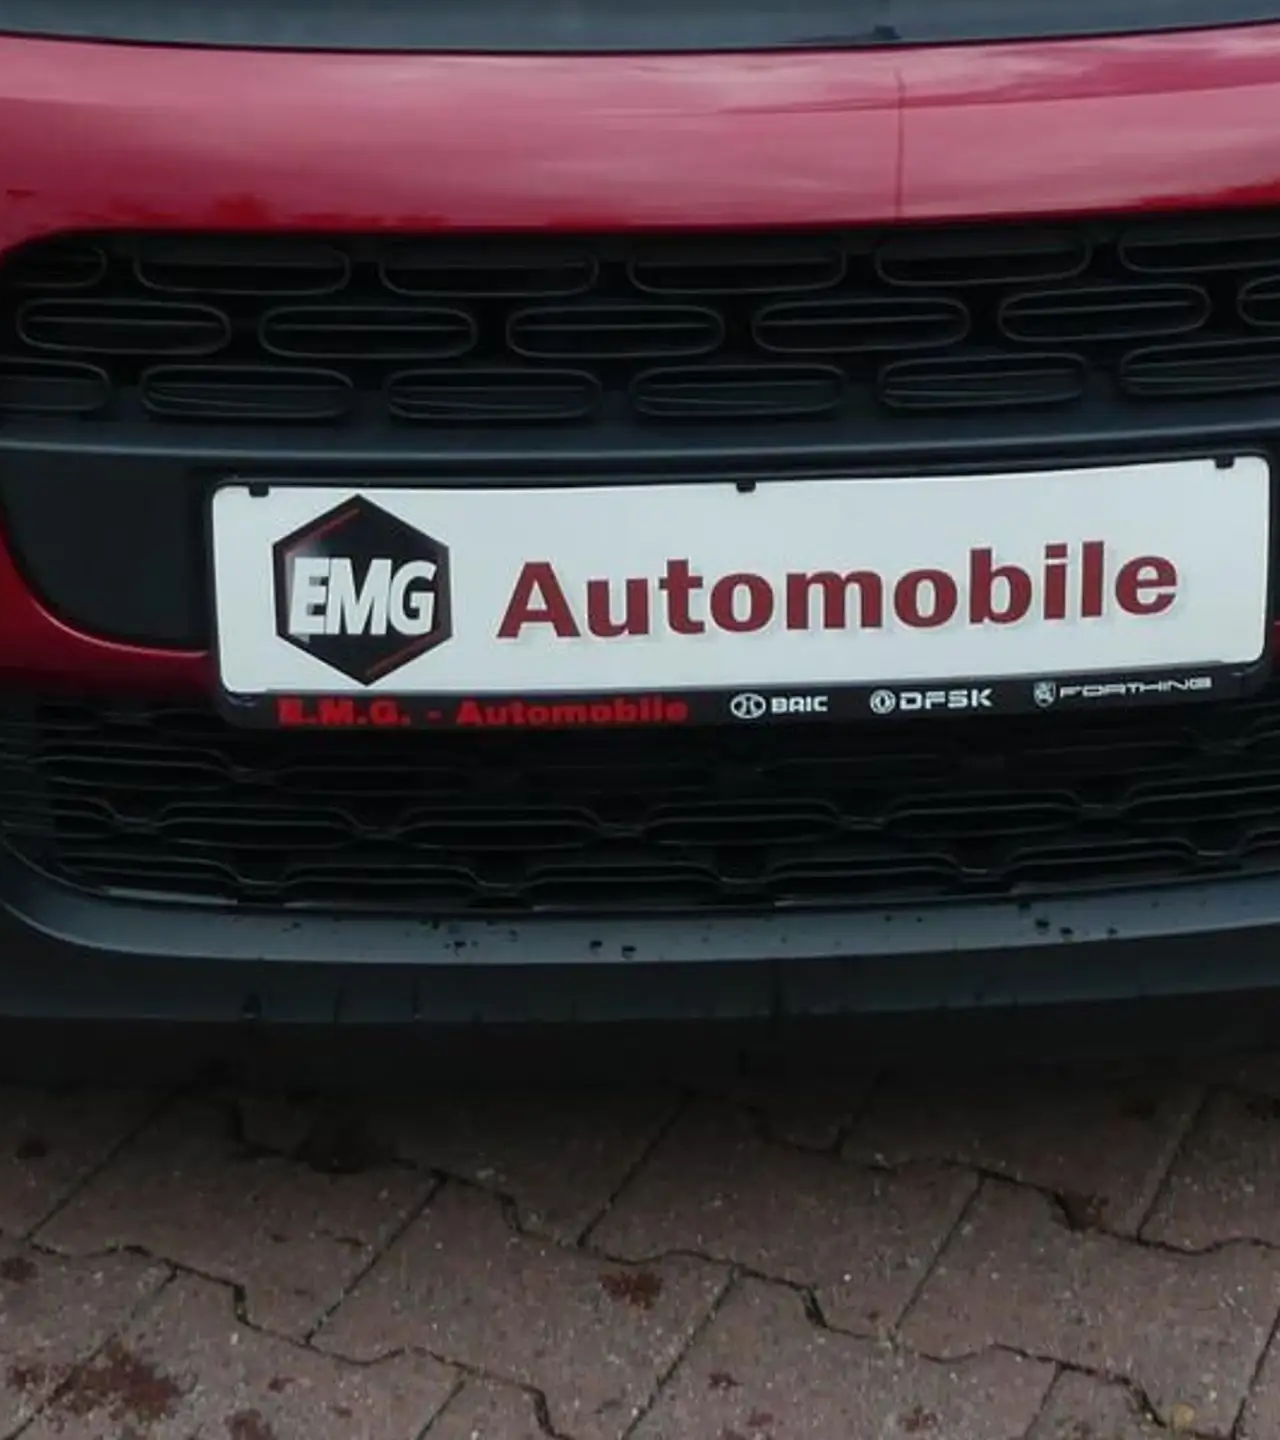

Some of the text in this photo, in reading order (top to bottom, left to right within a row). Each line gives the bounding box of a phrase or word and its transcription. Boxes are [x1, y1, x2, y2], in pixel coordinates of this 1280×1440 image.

[288, 540, 1179, 639] EMG Automobile
[899, 688, 994, 710] DFSK
[1058, 676, 1213, 698] FORTHING
[455, 696, 689, 727] Automobile
